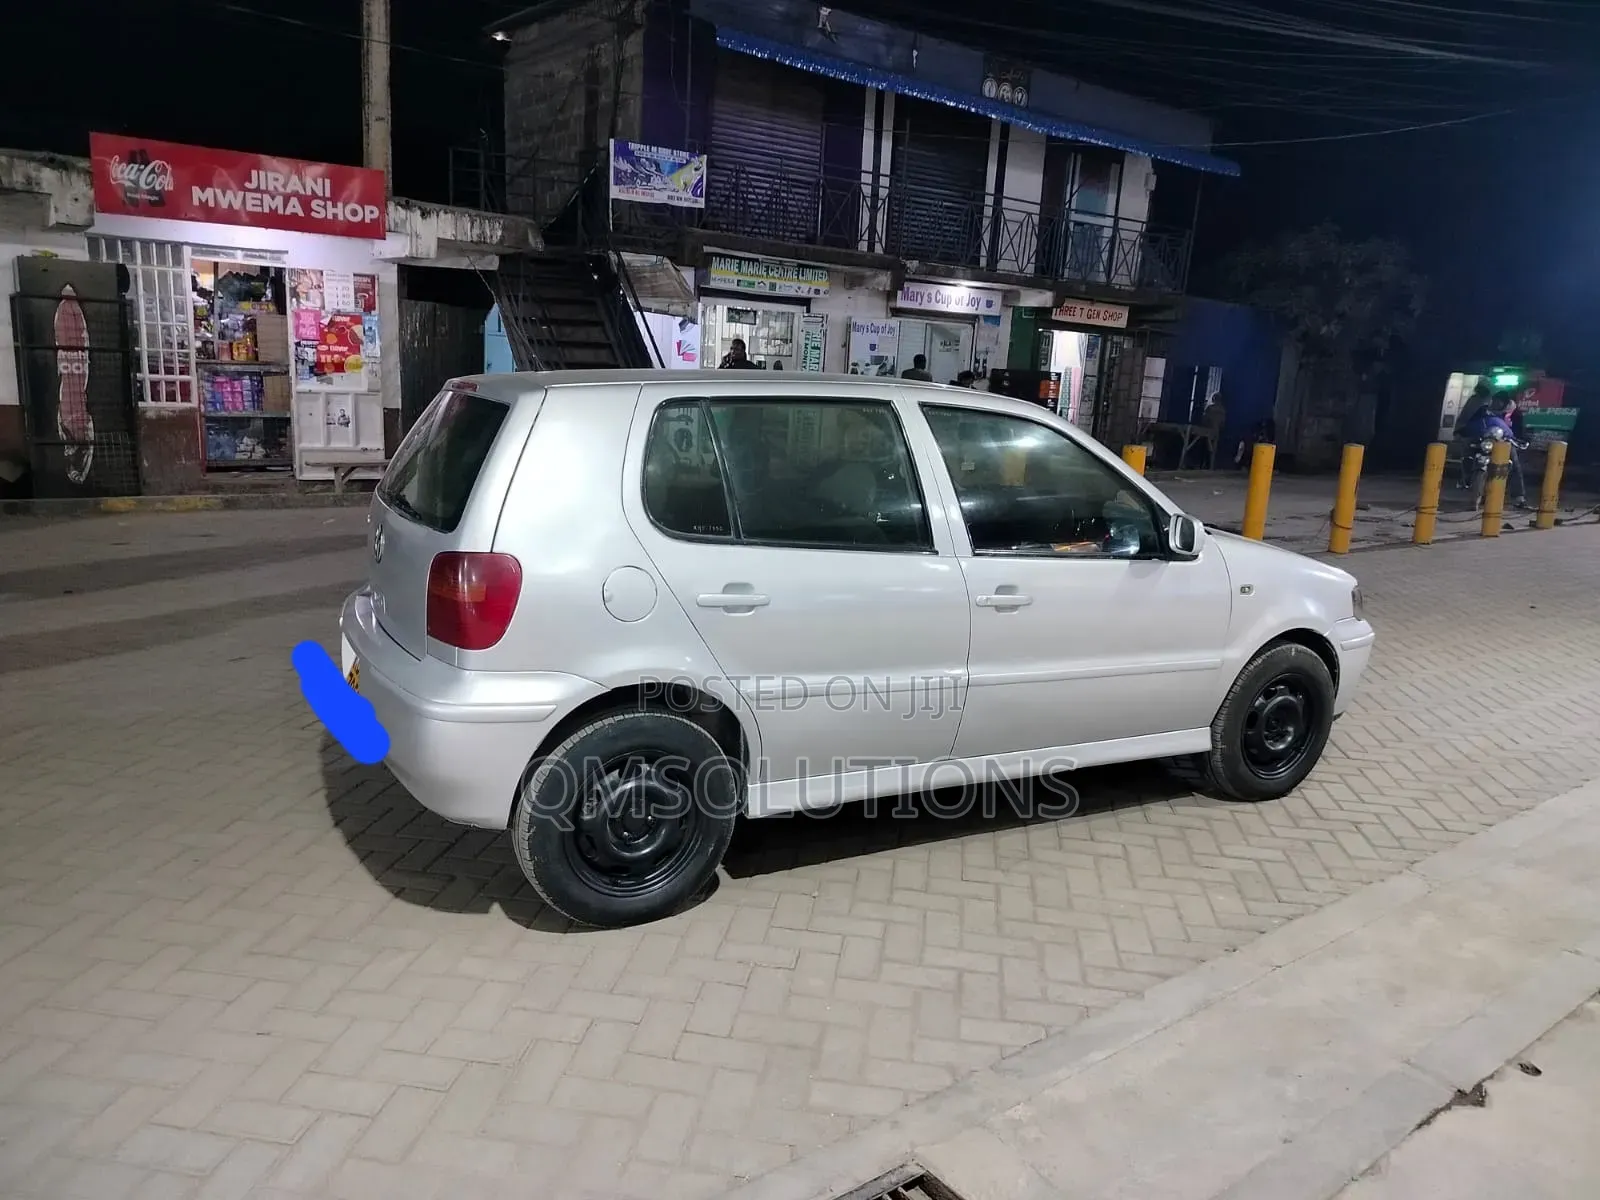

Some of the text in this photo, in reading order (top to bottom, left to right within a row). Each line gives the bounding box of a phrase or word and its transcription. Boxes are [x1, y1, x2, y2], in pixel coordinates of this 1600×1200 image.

[110, 155, 173, 191] Coca-Cola
[244, 169, 331, 197] JIRANI
[191, 186, 380, 224] MWEMA SHOP
[711, 256, 740, 273] MARIE
[740, 260, 767, 277] MARIE
[799, 267, 829, 282] LIMITED
[901, 287, 932, 306] Mary's
[934, 290, 952, 308] Cup
[966, 293, 982, 311] Joy
[1054, 305, 1123, 322] THREE T GEN SHOP
[870, 323, 880, 336] Cup
[881, 323, 887, 334] of
[887, 324, 897, 337] Joy
